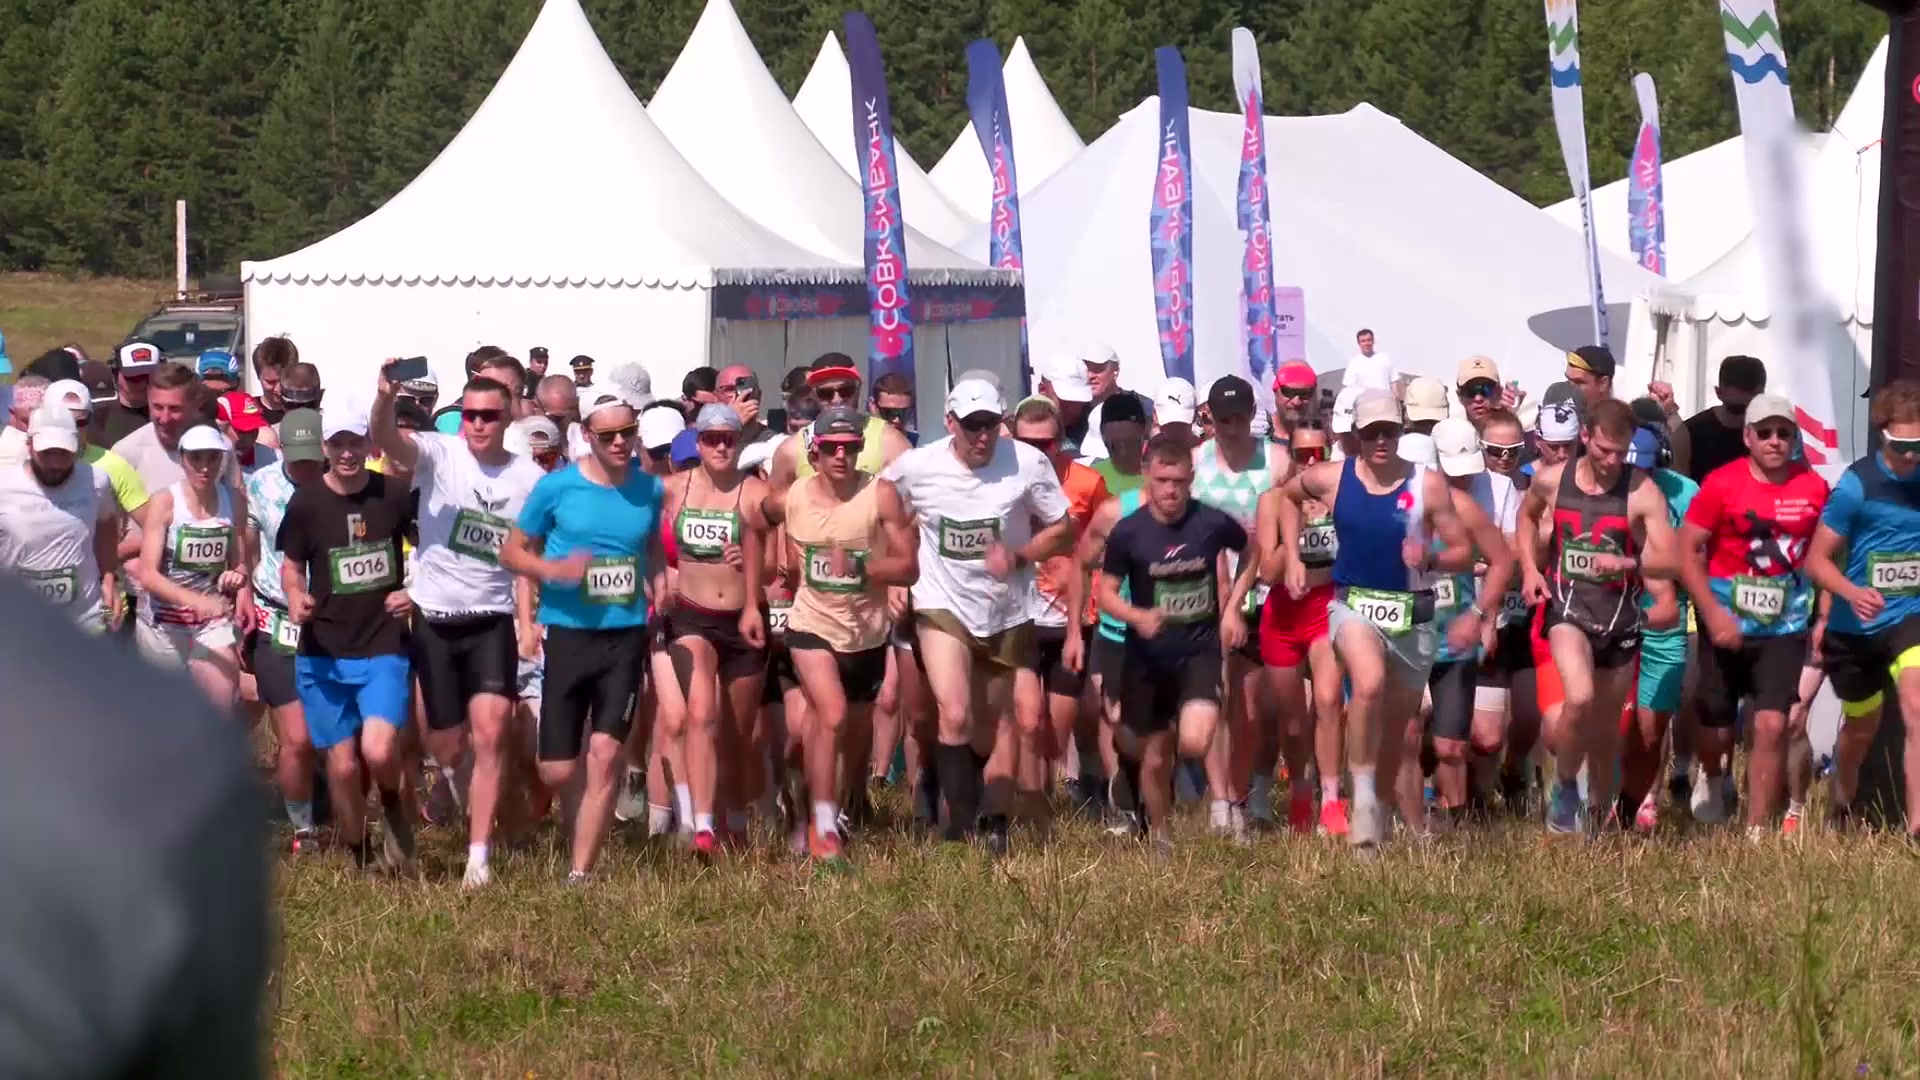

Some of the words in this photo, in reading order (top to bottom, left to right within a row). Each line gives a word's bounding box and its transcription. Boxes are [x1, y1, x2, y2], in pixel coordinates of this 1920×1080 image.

[462, 524, 504, 548] 1093
[686, 523, 728, 541] 1053
[949, 532, 986, 548] 1124
[186, 542, 223, 558] 1108
[343, 557, 384, 577] 1016
[814, 560, 855, 578] 10
[1568, 555, 1596, 569] 10
[592, 570, 633, 589] 1069
[1876, 565, 1918, 582] 1043
[1743, 591, 1778, 608] 1126
[770, 613, 788, 628] 02
[1360, 604, 1399, 622] 1106
[284, 626, 298, 642] 11
